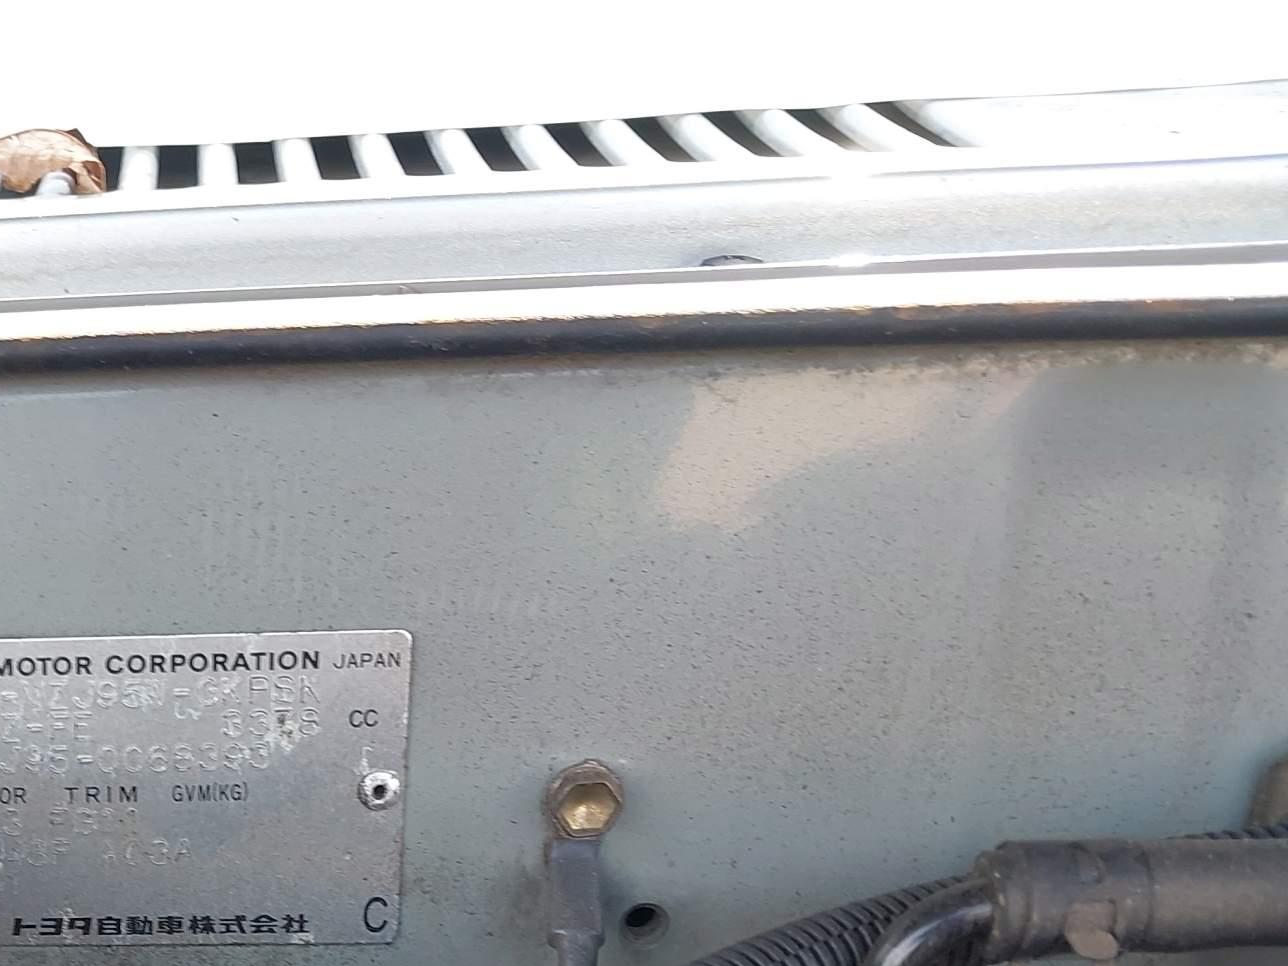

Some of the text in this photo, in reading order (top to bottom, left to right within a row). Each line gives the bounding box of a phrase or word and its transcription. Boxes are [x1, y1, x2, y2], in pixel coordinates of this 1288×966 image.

[105, 651, 320, 675] CORPORATION
[333, 652, 401, 670] JAPAN
[348, 709, 379, 728] CC
[63, 786, 139, 804] TRIM
[171, 781, 249, 802] GVM(KG)
[11, 913, 311, 936] トヨタ自動車株式会社
[363, 896, 388, 933] C
